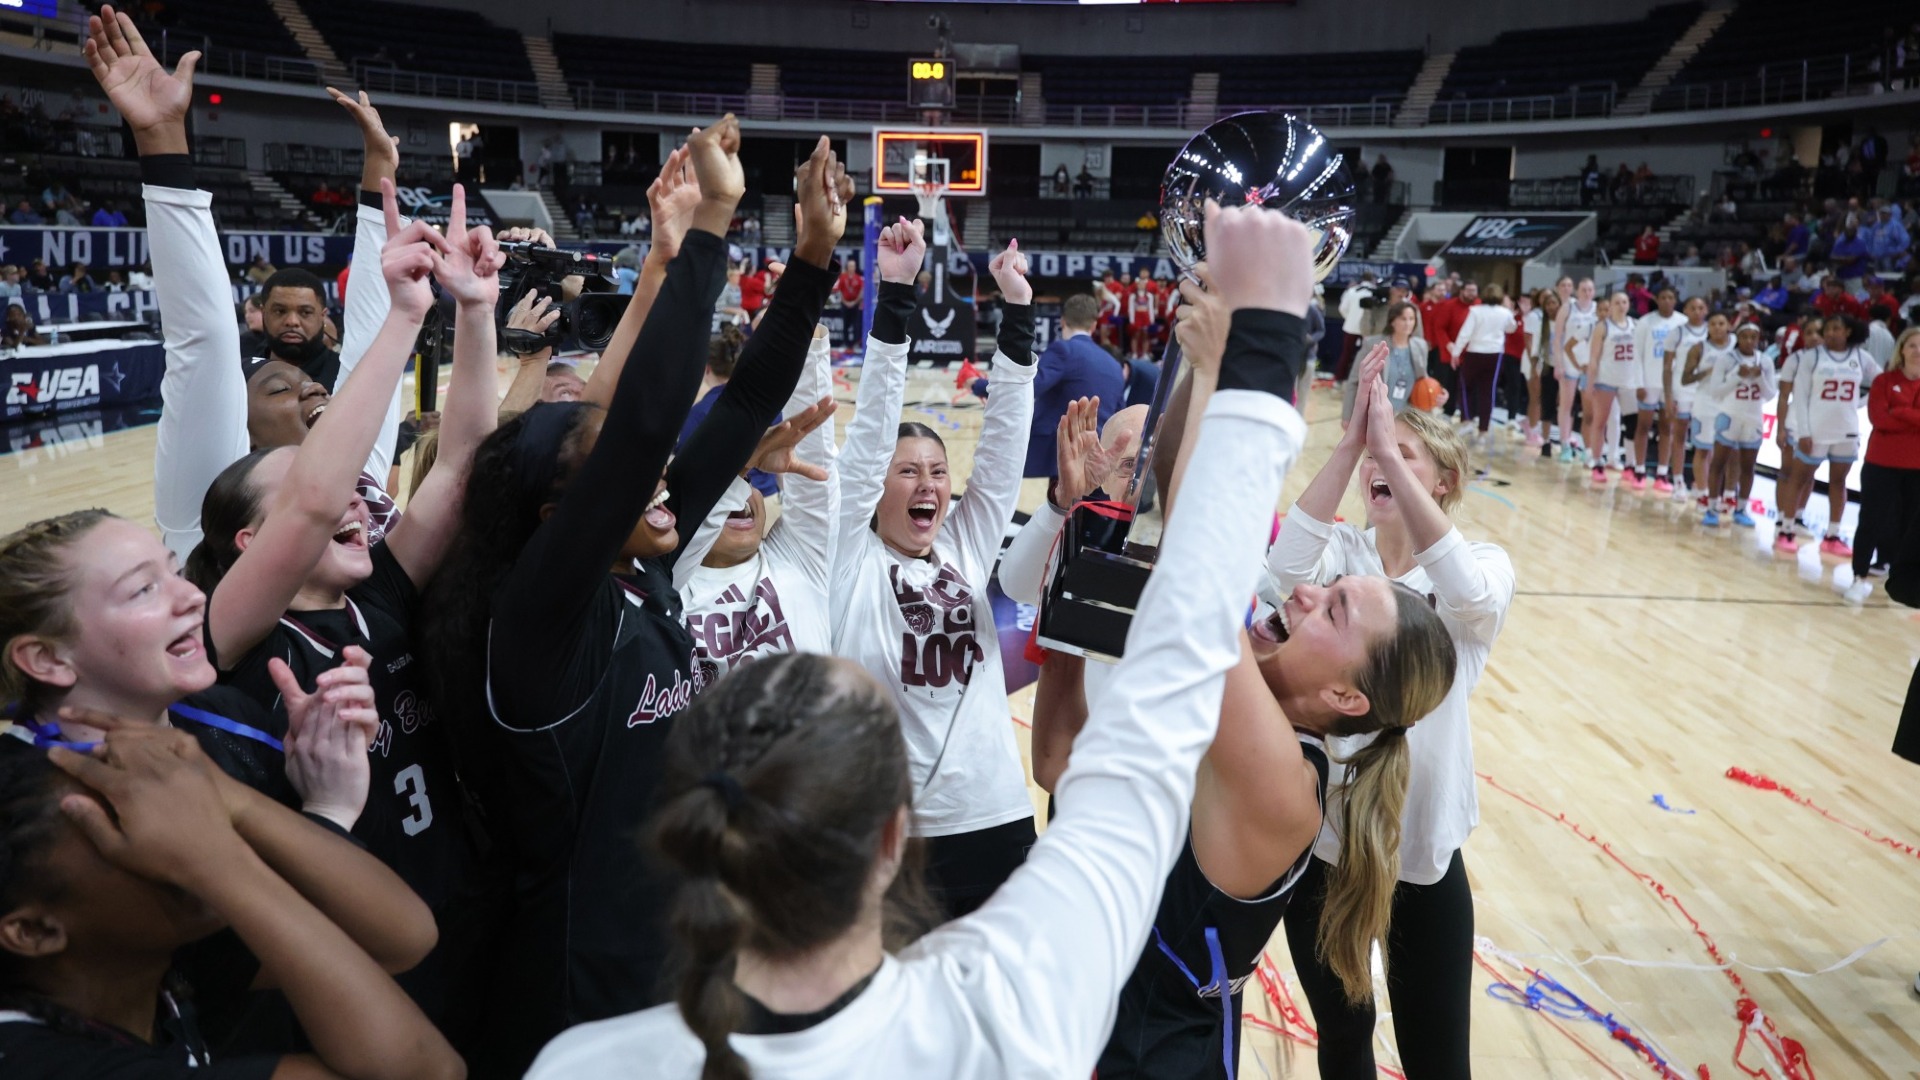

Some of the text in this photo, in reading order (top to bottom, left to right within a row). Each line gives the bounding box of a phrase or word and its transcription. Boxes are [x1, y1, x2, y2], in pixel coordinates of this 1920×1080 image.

[1465, 217, 1527, 239] VBC
[42, 230, 92, 267] NO
[228, 235, 270, 264] ON
[284, 235, 326, 264] US
[1613, 344, 1635, 361] 25
[1736, 382, 1761, 400] 22
[1820, 379, 1857, 402] 23
[394, 763, 434, 837] 3
